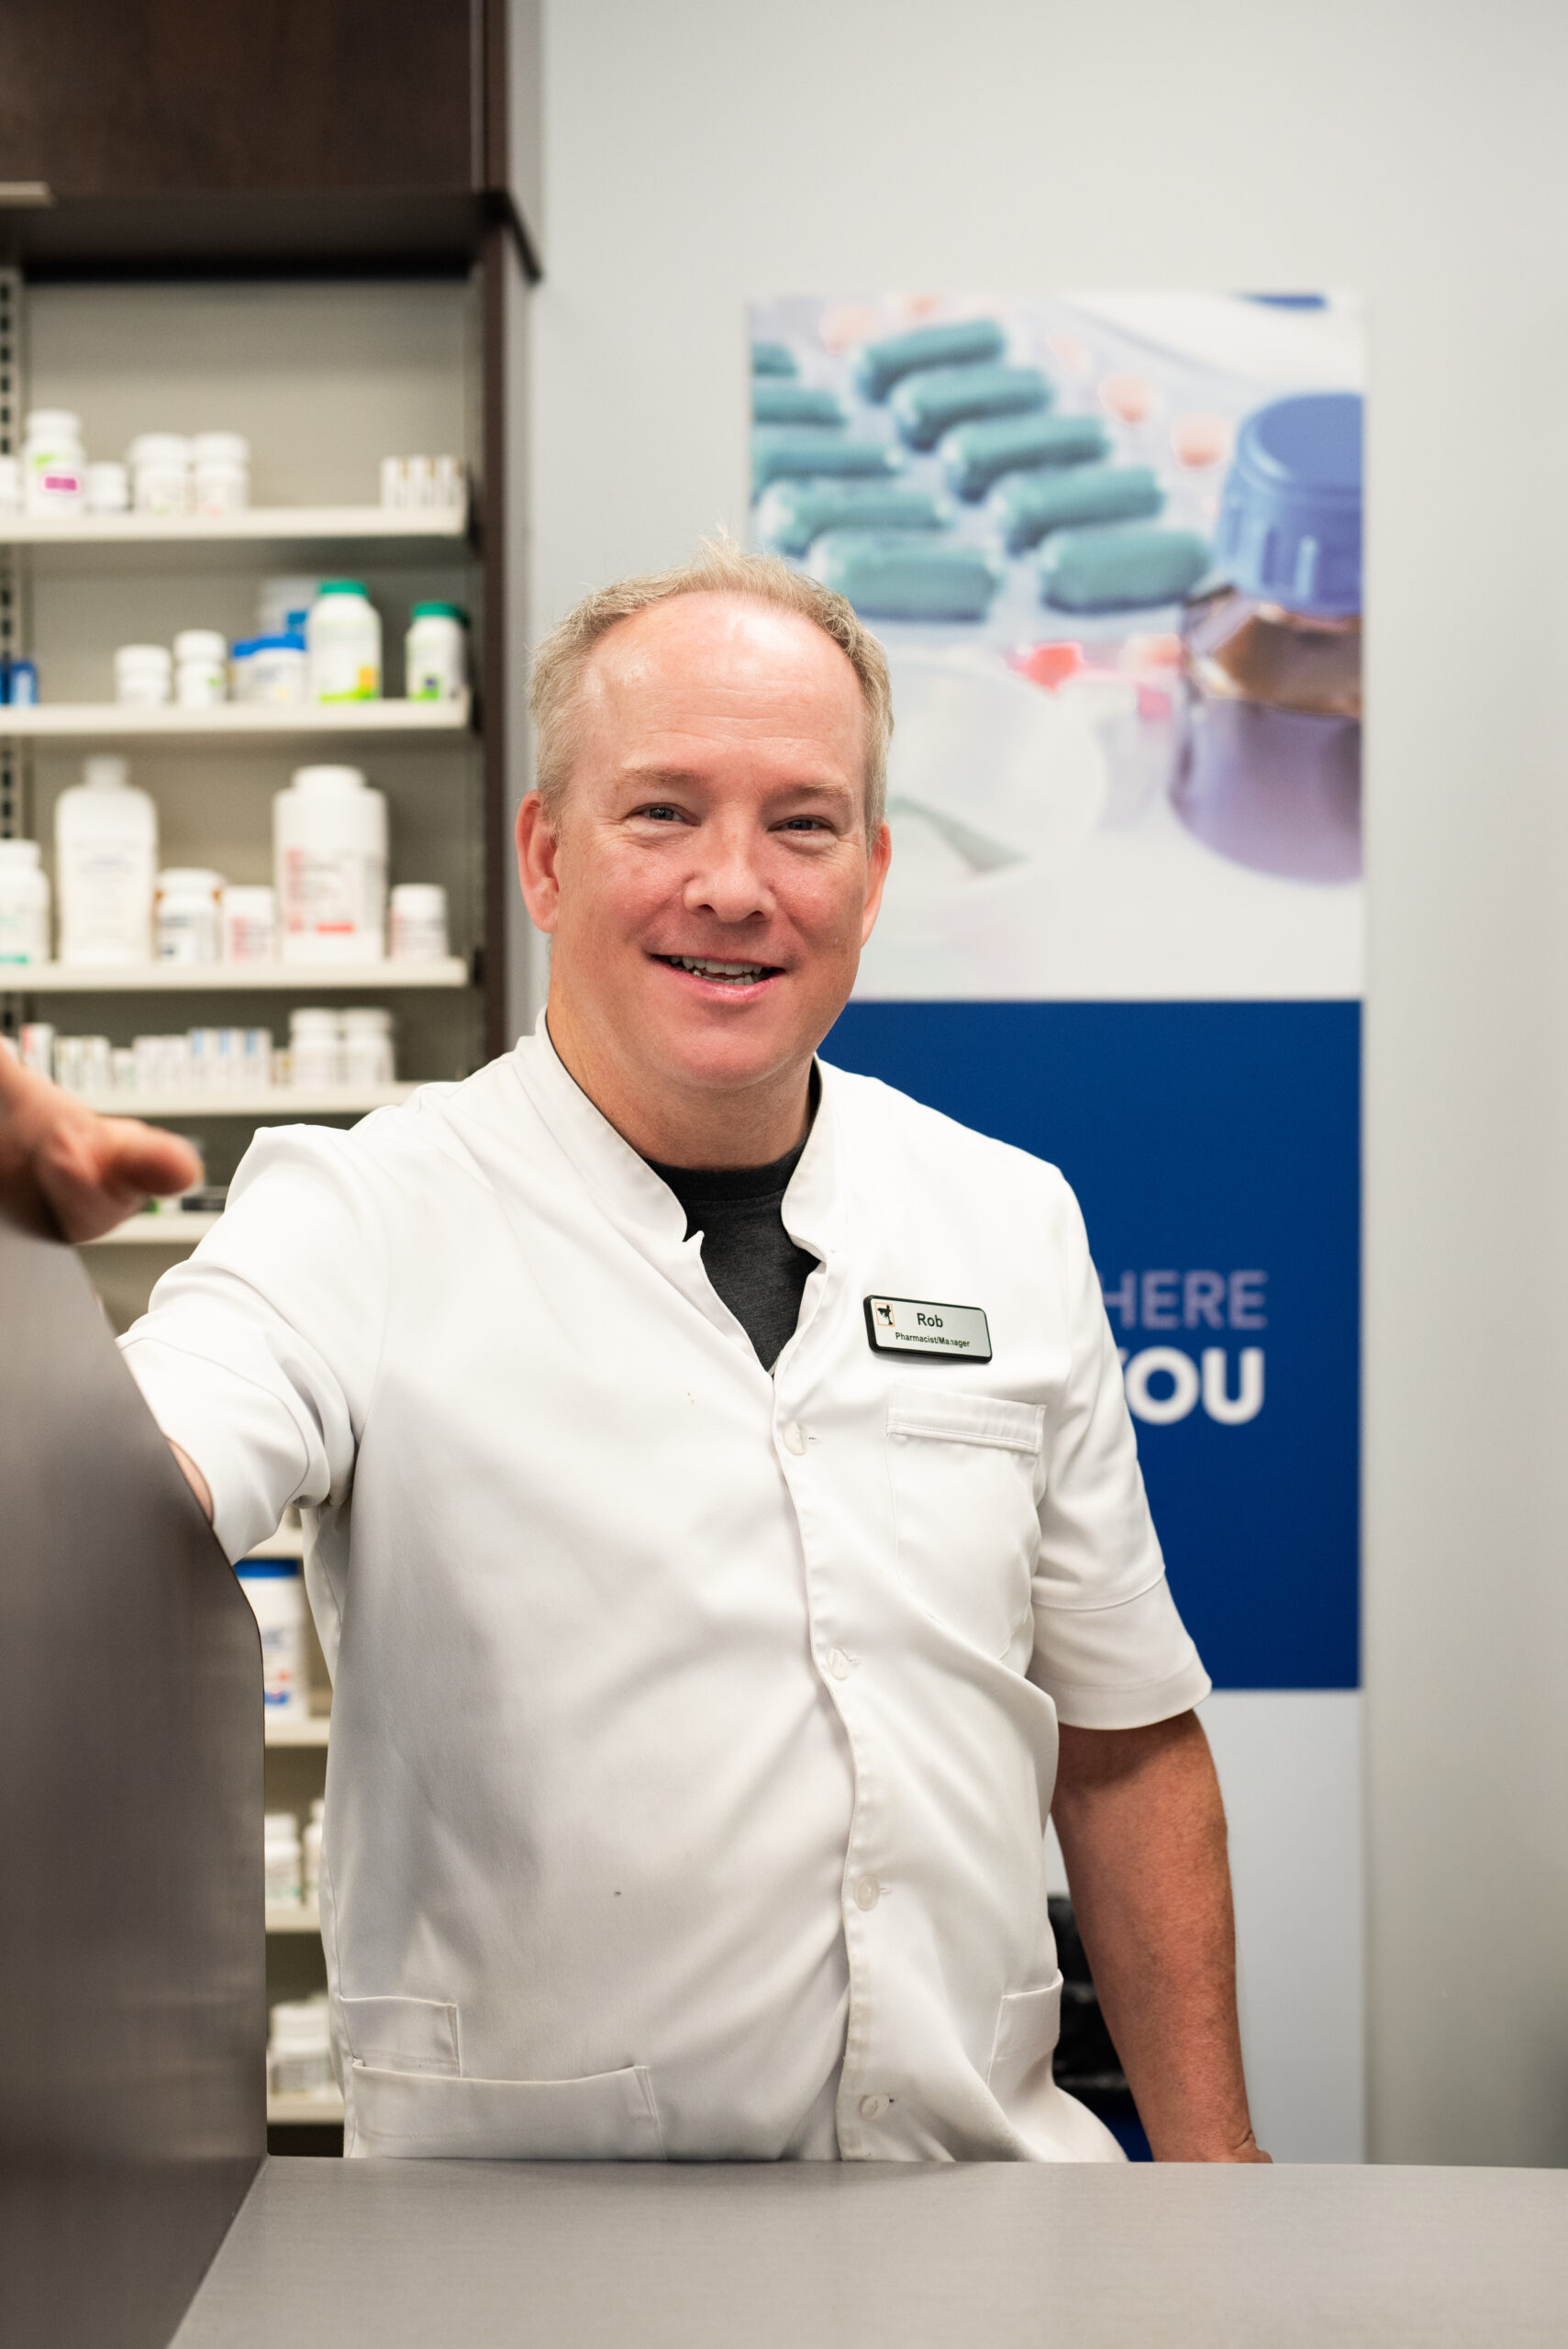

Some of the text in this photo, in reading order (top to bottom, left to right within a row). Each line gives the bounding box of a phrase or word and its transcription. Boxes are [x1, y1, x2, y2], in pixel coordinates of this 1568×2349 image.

[1099, 1269, 1268, 1330] HERE
[917, 1313, 943, 1328] Rob
[895, 1332, 970, 1348] Pharmacist/Manager
[1116, 1345, 1265, 1425] OU
